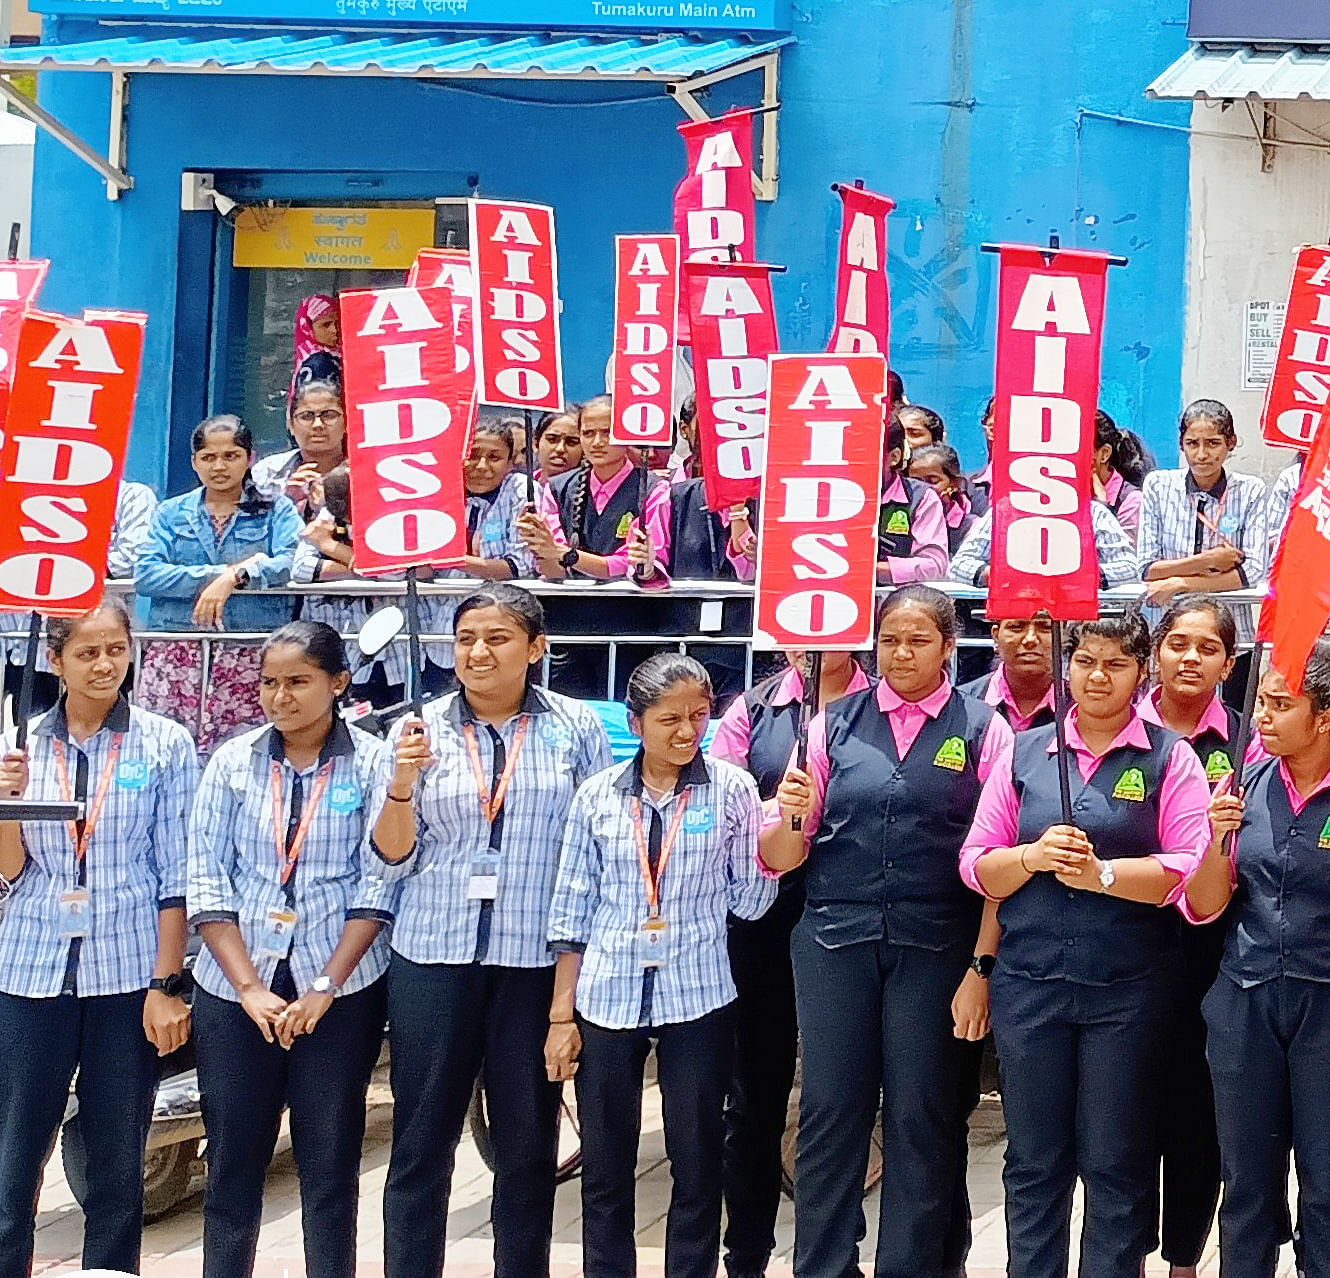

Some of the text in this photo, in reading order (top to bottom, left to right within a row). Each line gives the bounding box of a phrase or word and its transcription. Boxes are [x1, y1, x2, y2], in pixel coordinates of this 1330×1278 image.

[591, 2, 757, 18] Tumakuru Main Atm
[304, 251, 372, 265] Welcome
[687, 131, 745, 263] AID
[834, 213, 878, 353] AID
[489, 209, 551, 400] AIDSO
[621, 243, 669, 436] AIDSO
[700, 277, 768, 480] AIDSO
[1250, 312, 1269, 322] BUY
[1250, 328, 1271, 338] SELL
[0, 325, 124, 601] AIDSO
[357, 289, 457, 556] AIDSO
[775, 365, 868, 636] AIDSO
[1005, 274, 1093, 576] AIDSO
